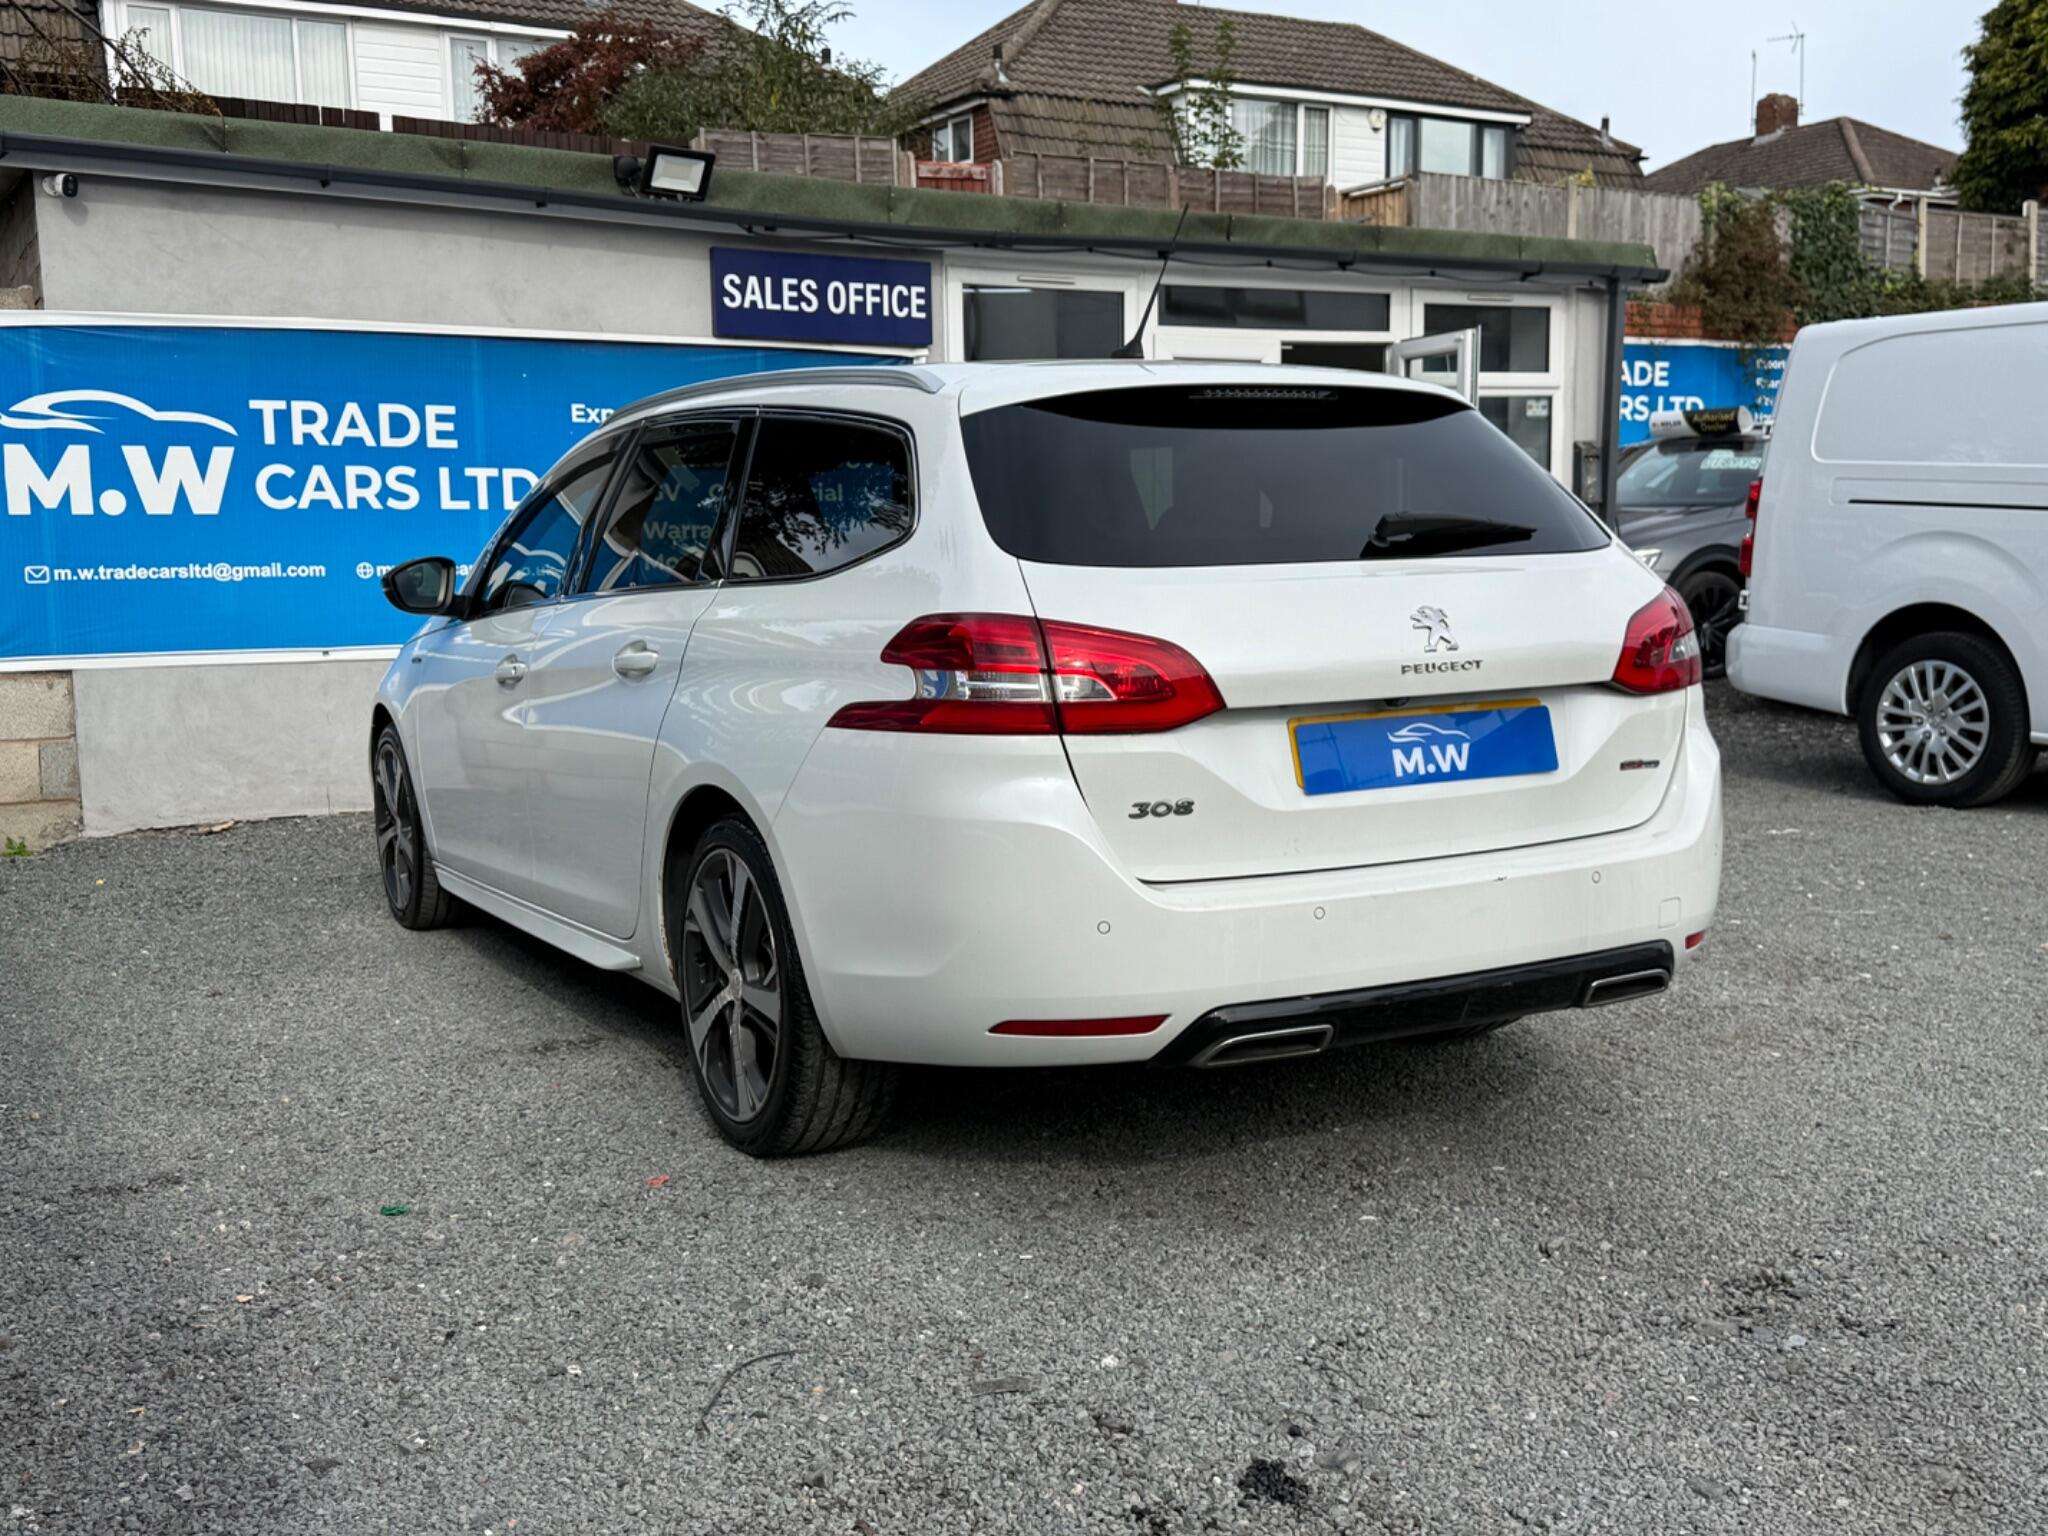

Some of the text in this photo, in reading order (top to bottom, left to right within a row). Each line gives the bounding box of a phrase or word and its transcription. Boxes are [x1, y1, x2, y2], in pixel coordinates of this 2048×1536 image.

[722, 273, 926, 319] SALES OFFICE
[248, 399, 458, 449] TRADE
[4, 443, 235, 515] M.W
[255, 464, 539, 511] CARS LTD
[54, 563, 326, 581] m.w.tradecarsltd@gmail.com
[1401, 660, 1483, 675] PEUGEOT
[1392, 742, 1470, 777] M.W
[1128, 799, 1195, 819] 308
